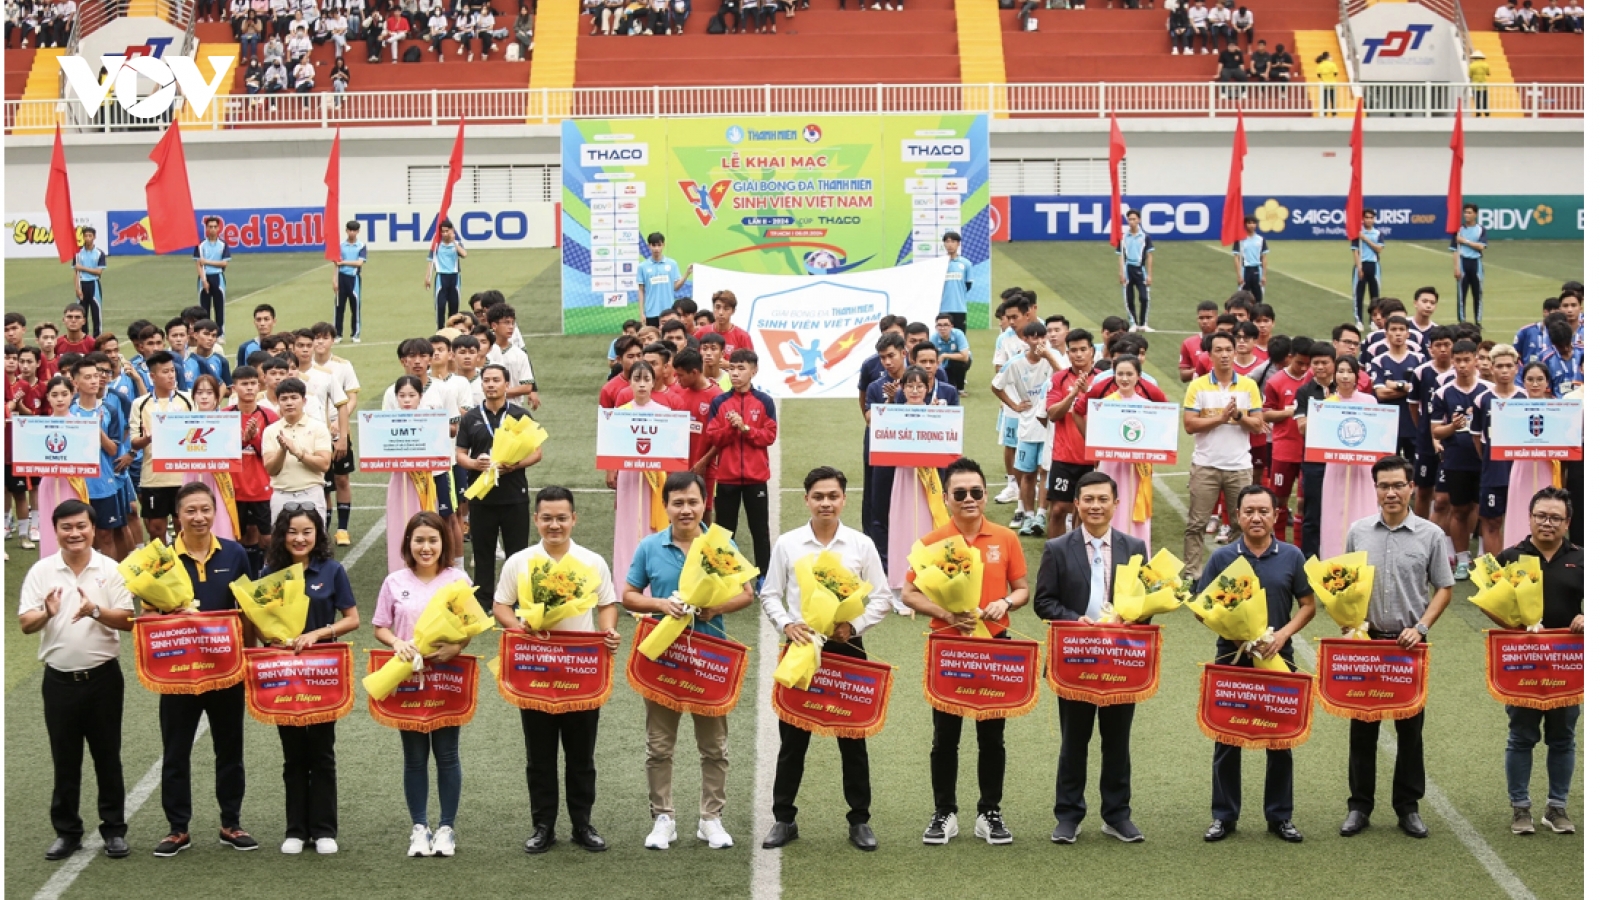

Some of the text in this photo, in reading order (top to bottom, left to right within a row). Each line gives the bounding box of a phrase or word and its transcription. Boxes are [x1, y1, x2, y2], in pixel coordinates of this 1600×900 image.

[586, 149, 643, 160] THACO
[907, 144, 964, 156] THACO
[721, 151, 827, 170] LỄ KHAI MẠC
[733, 196, 768, 209] SINH
[769, 194, 803, 209] VIÊN
[836, 195, 873, 208] NAM
[818, 216, 862, 224] THACO
[1292, 208, 1412, 224] SAIGOURIST
[1478, 208, 1534, 230] BIDV
[264, 212, 326, 246] Bull
[756, 318, 787, 329] SINH
[791, 318, 820, 330] VIÊN
[854, 312, 882, 326] NAM
[390, 428, 417, 436] UMT
[630, 424, 658, 434] VLU
[874, 426, 896, 440] GIÁM
[945, 428, 958, 442] TÀI
[1274, 472, 1284, 486] 10
[1488, 493, 1495, 507] 3
[210, 635, 230, 644] NAM
[1063, 646, 1084, 654] SINH
[1125, 649, 1146, 657] NAM
[514, 653, 534, 662] SINH
[1113, 659, 1145, 667] THACO
[940, 659, 961, 668] SINH
[1002, 664, 1025, 673] NAM
[1393, 665, 1413, 674] NAM
[991, 674, 1024, 683] THACO
[1380, 675, 1412, 684] THACO
[852, 684, 875, 695] NAM
[840, 692, 872, 705] THACO
[1215, 690, 1235, 699] SINH
[1276, 696, 1298, 705] NAM
[1265, 705, 1297, 714] THACO
